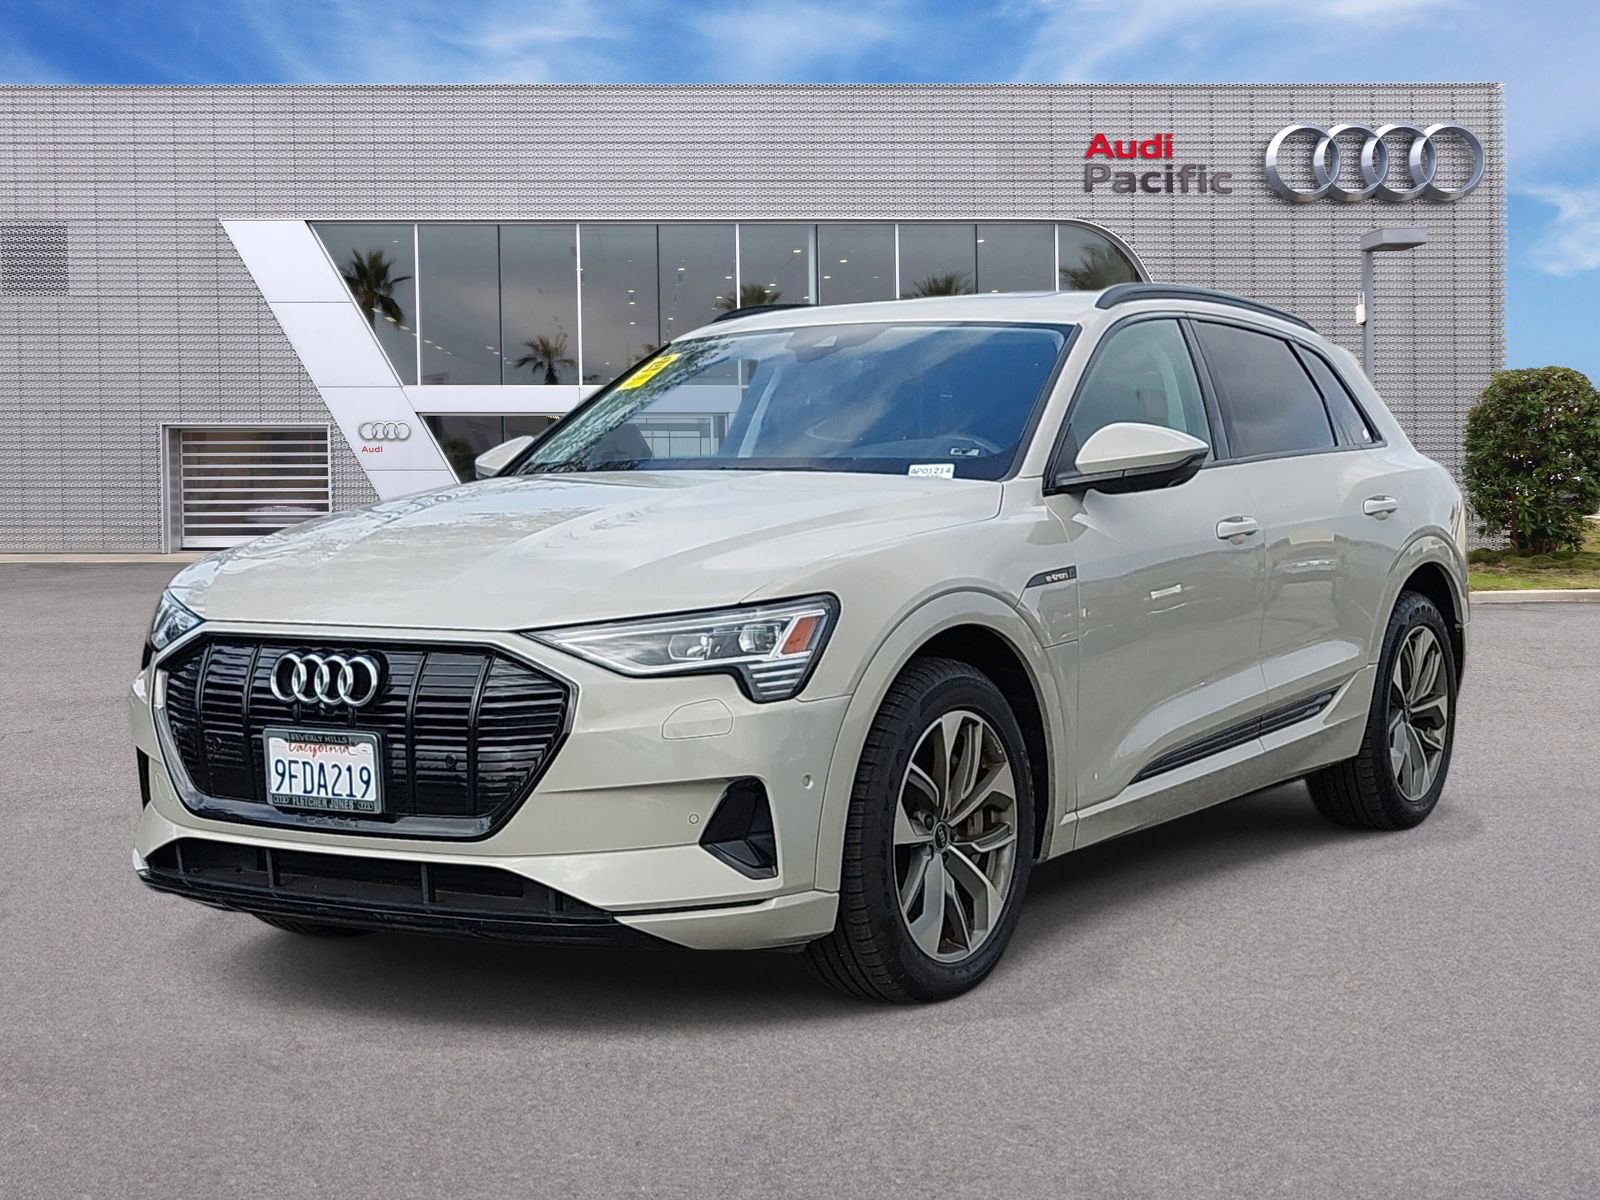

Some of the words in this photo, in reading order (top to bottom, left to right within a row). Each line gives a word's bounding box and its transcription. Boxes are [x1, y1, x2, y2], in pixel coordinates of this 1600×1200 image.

[1085, 132, 1173, 159] Audi
[1084, 163, 1233, 194] Pacific
[291, 733, 322, 742] BEVERLY
[288, 743, 357, 757] California
[274, 758, 371, 798] 9FDA219
[292, 796, 327, 808] FLETCHER
[329, 799, 354, 810] JONES
